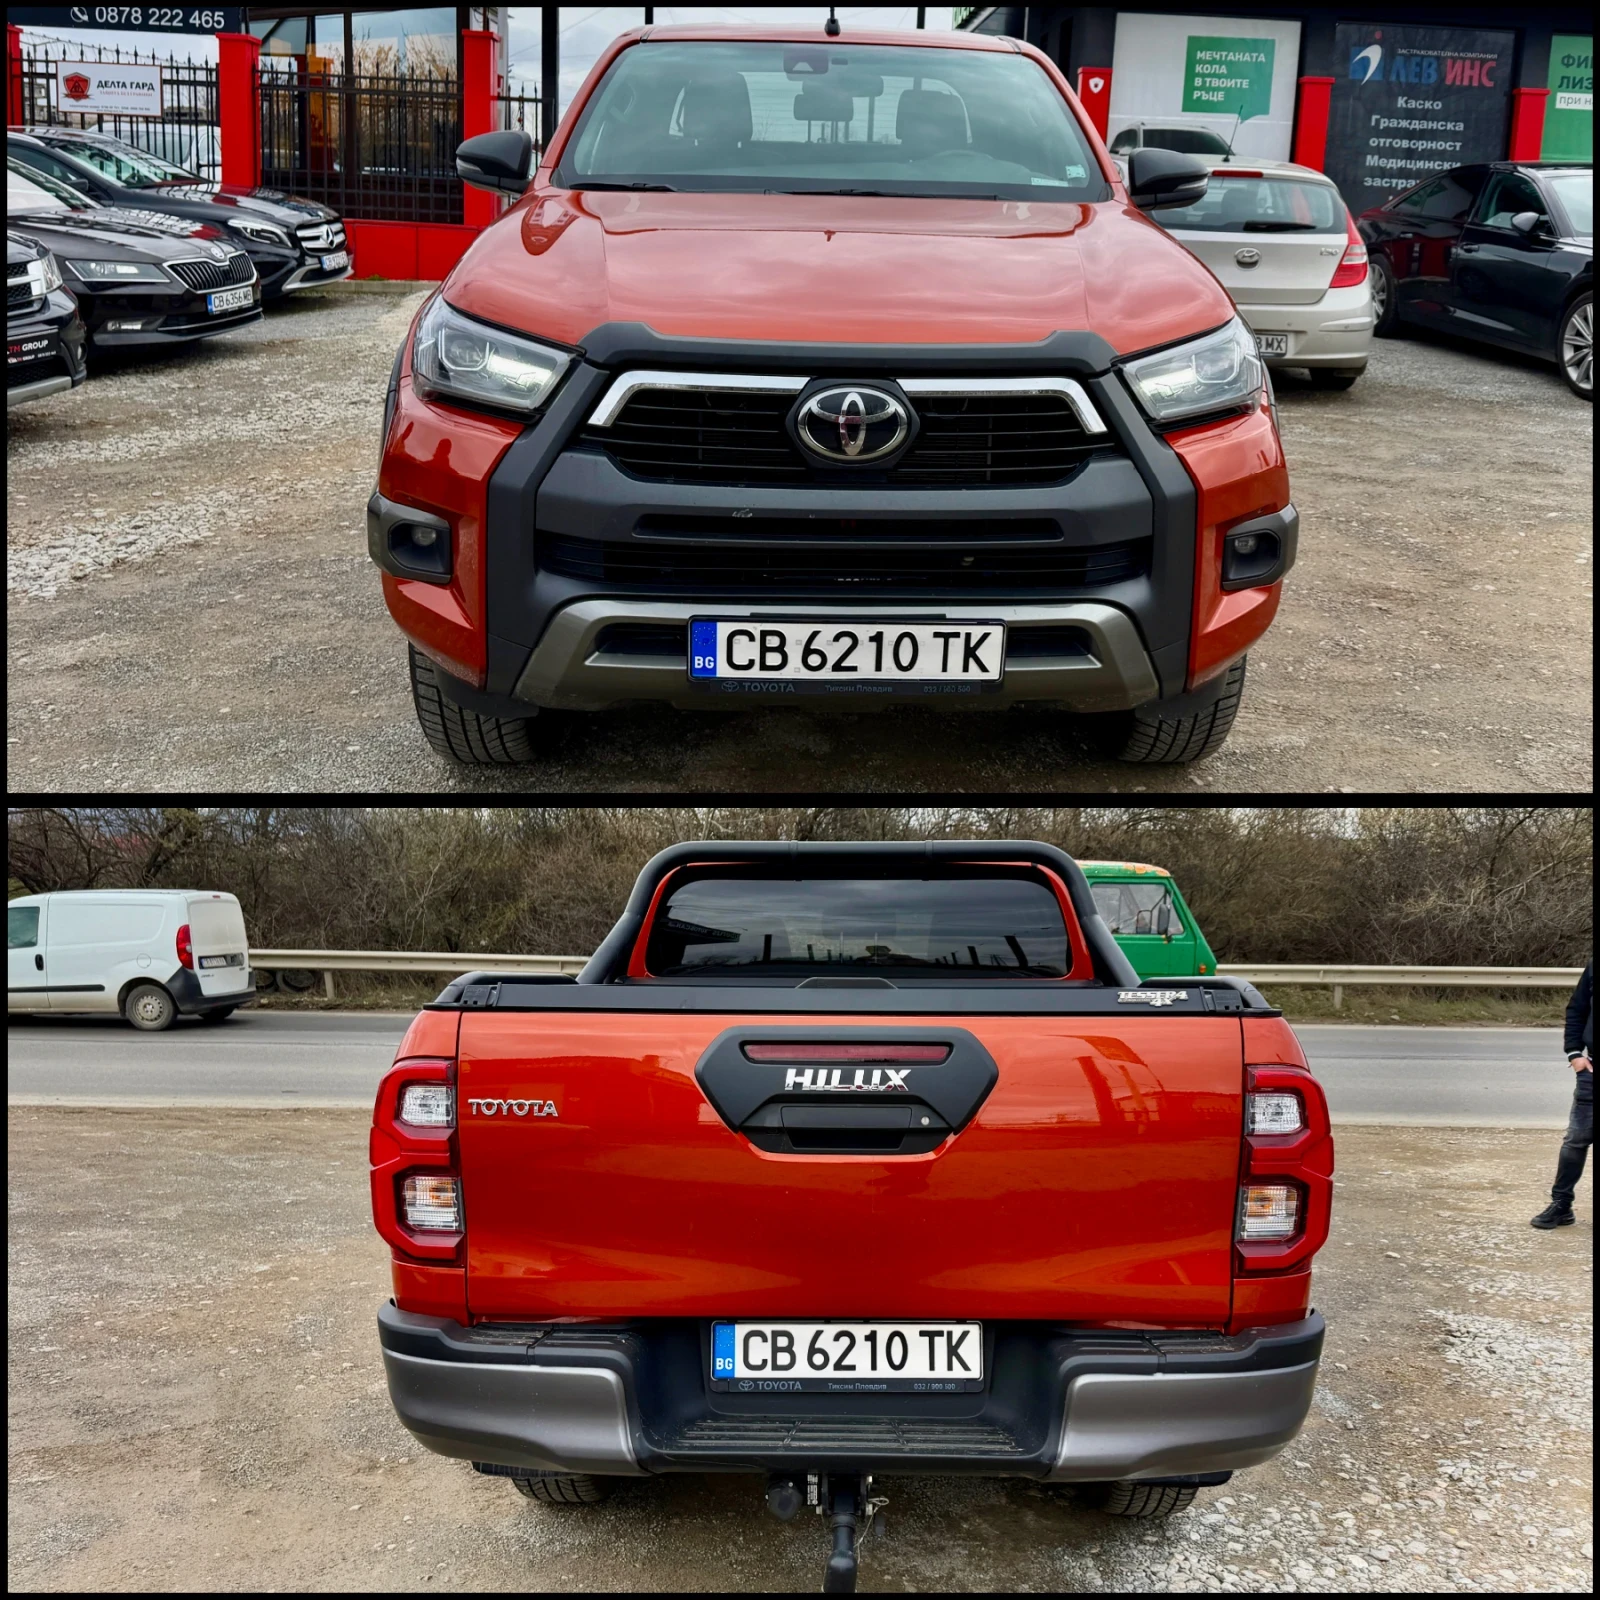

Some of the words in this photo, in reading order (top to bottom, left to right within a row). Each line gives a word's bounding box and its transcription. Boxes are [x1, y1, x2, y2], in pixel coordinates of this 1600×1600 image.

[95, 7, 142, 24] 0878
[148, 8, 183, 26] 222
[189, 10, 225, 29] 465
[1196, 50, 1266, 62] МЕЧТАНАТА
[1397, 48, 1458, 57] ЗАСТРАХОВАТЕЛНА
[1195, 64, 1227, 74] КОЛА
[1390, 56, 1438, 84] ЛЕВ
[1445, 59, 1497, 87] ИНС
[96, 80, 127, 89] ДЕЛТА
[130, 82, 155, 91] ГАРД
[1194, 77, 1202, 87] В
[1204, 78, 1250, 88] ТВОИТЕ
[1193, 90, 1225, 102] РЪЦЕ
[1560, 96, 1581, 106] при
[1397, 96, 1442, 110] Каско
[1371, 115, 1464, 131] Гражданска
[1369, 137, 1462, 151] отговорност
[1366, 155, 1462, 170] Медицински
[1363, 177, 1420, 190] застра
[22, 340, 48, 351] GROUP
[1265, 337, 1284, 351] MX
[726, 629, 789, 672] CB
[801, 630, 920, 673] 6210
[933, 631, 992, 673] TK
[694, 656, 715, 669] BG
[742, 681, 796, 694] TOYOTA
[856, 685, 893, 694] Пловдив
[784, 1068, 912, 1092] HILUX
[468, 1098, 559, 1117] TOYOTA
[742, 1329, 797, 1372] CB
[806, 1329, 909, 1372] 6210
[918, 1329, 972, 1372] TK
[716, 1357, 733, 1370] BG
[756, 1380, 802, 1391] TOYOTA
[855, 1382, 887, 1392] Пловдив
